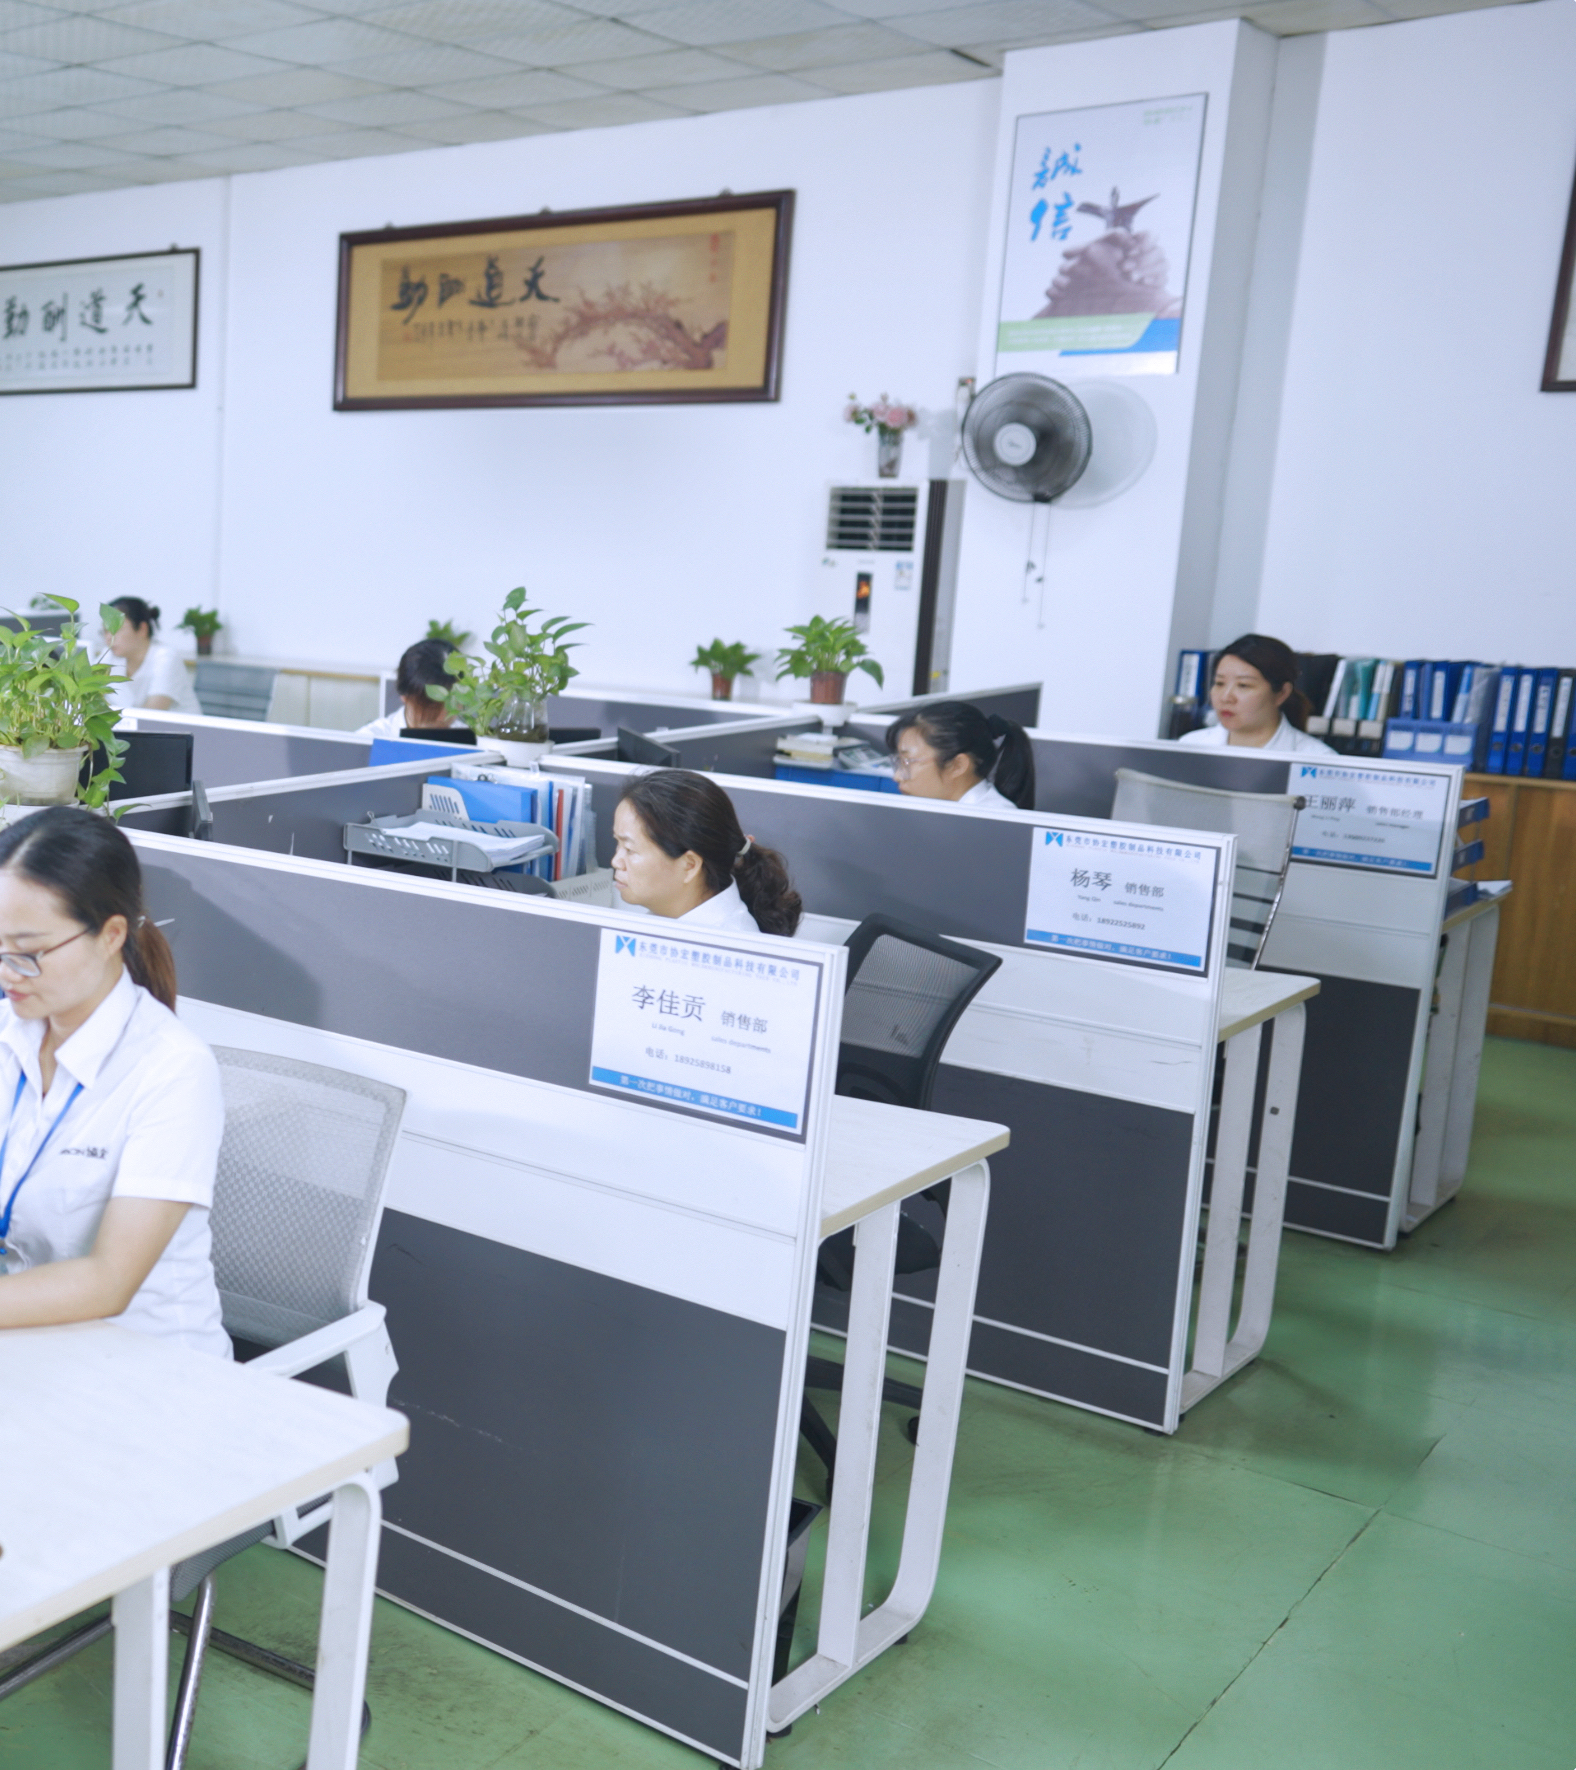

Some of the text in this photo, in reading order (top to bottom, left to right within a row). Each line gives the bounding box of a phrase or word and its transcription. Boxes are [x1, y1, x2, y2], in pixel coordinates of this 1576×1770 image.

[1070, 868, 1165, 898] 杨琴 销售部
[632, 984, 769, 1034] 李佳贡 销售部
